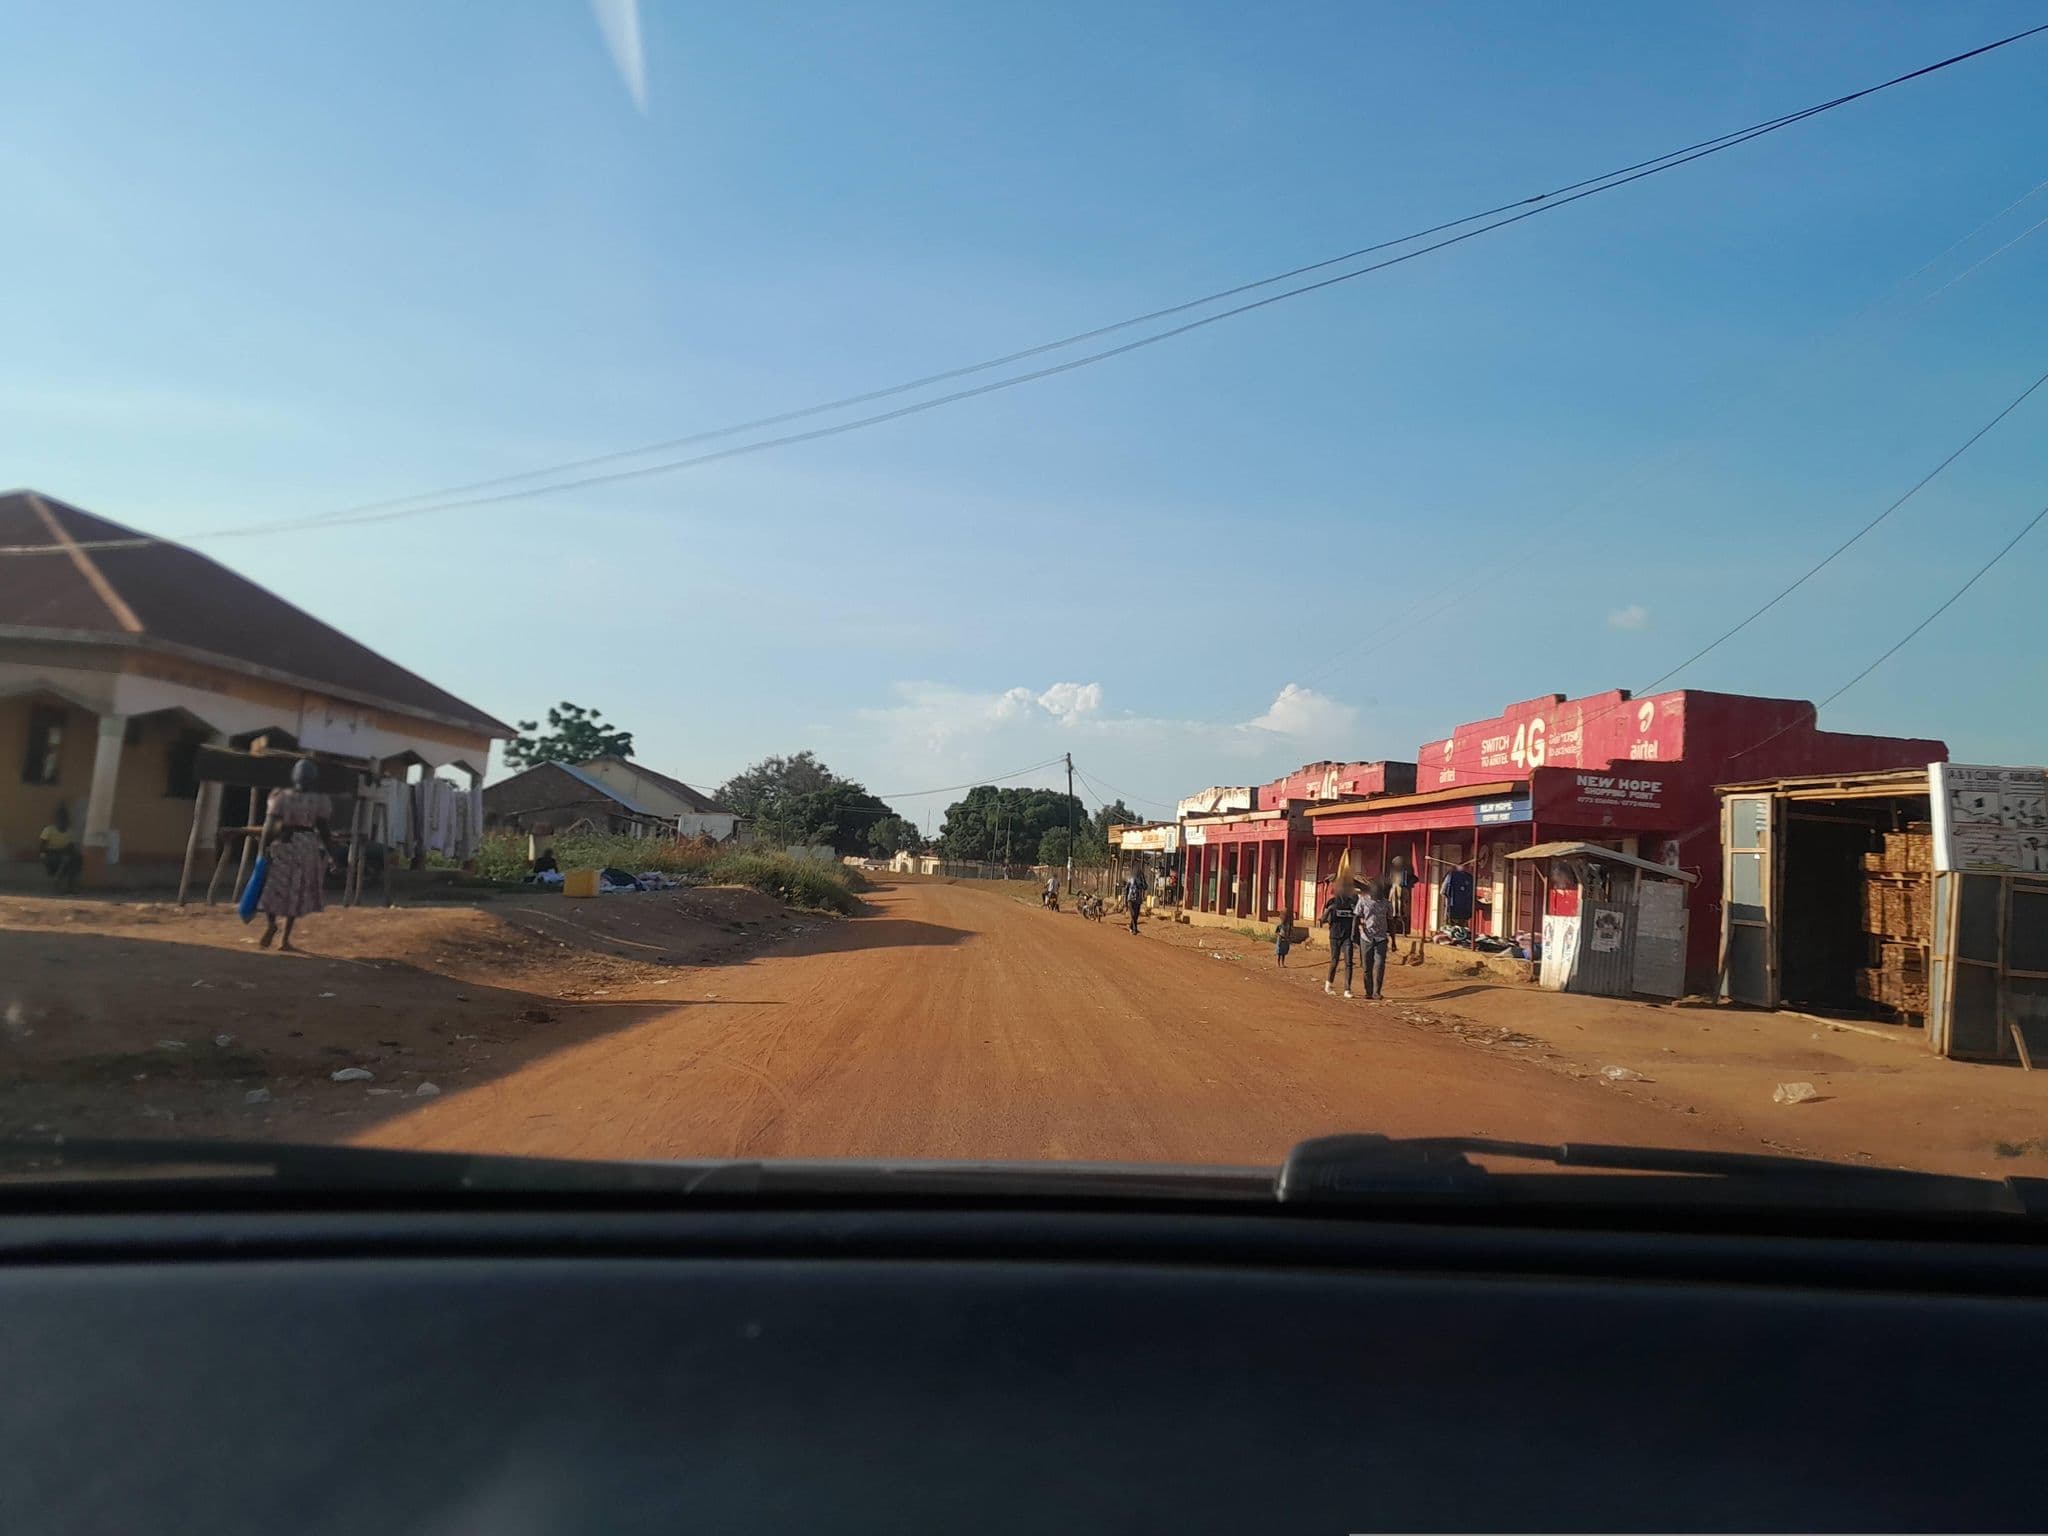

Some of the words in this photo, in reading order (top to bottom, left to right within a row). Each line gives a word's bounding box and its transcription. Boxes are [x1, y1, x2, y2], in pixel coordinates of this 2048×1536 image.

[1481, 735, 1509, 754] SWITCH
[1511, 718, 1545, 769] 4G
[1630, 738, 1659, 760] airtel
[1576, 775, 1615, 788] NEW
[1618, 778, 1663, 792] HOPE
